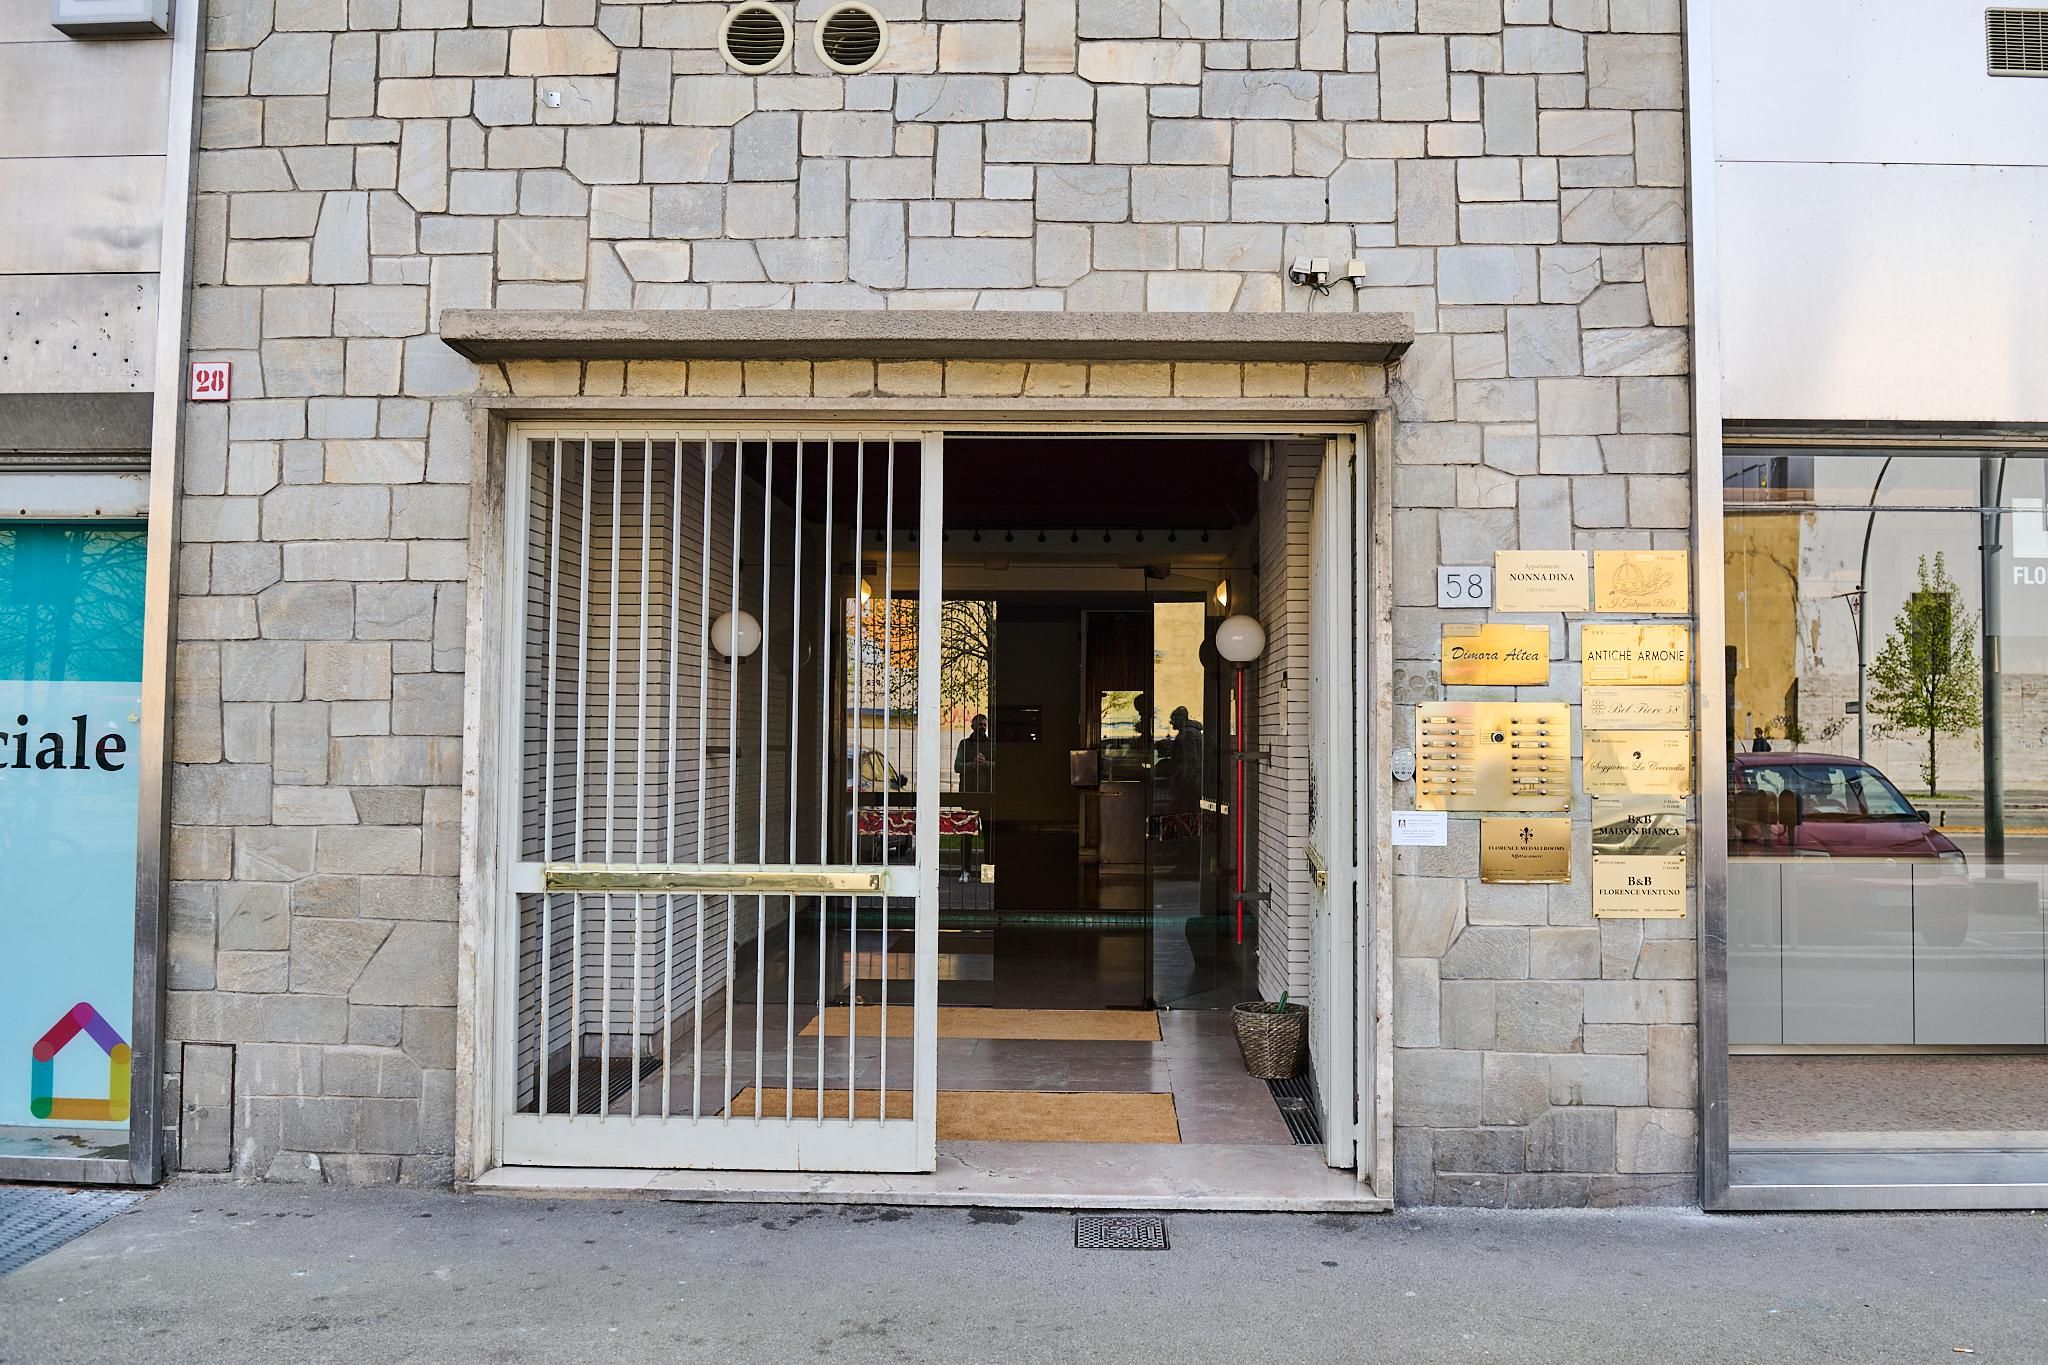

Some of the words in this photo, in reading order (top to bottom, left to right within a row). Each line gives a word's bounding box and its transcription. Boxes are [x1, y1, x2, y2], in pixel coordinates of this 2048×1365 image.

[196, 370, 225, 392] 28
[1509, 573, 1547, 581] NONNA
[1549, 573, 1575, 581] DINA
[2013, 566, 2048, 585] FLO
[1446, 573, 1483, 599] 58
[1451, 646, 1499, 660] Dimora
[1503, 648, 1540, 662] Altea
[1637, 650, 1685, 661] ARMONIE
[1590, 760, 1629, 773] Soggiorno
[1632, 761, 1645, 771] La
[1627, 814, 1652, 824] B&B
[1599, 827, 1639, 835] MAISON
[1641, 827, 1680, 836] BIANCA
[1627, 876, 1652, 886] B&B
